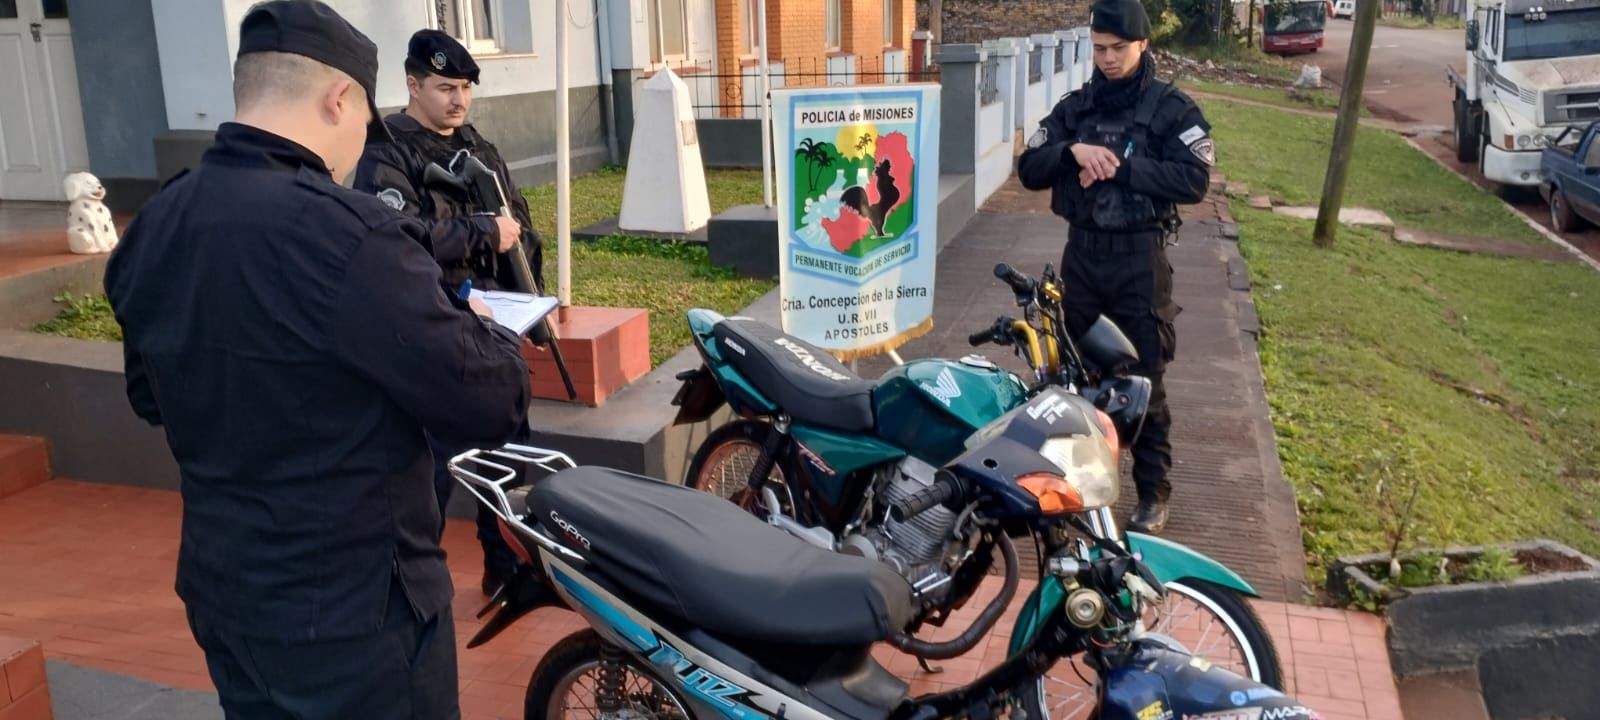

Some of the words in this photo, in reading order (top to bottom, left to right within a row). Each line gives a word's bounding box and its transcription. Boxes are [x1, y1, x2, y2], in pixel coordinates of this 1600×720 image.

[801, 110, 846, 124] POLICIA
[849, 109, 861, 121] de
[863, 107, 914, 120] MISIONES
[795, 254, 842, 273] PERMANENTE
[844, 260, 874, 277] VOCACION
[874, 256, 884, 268] DE
[883, 243, 911, 264] SERVICIO
[872, 291, 882, 302] de
[885, 288, 894, 300] la
[896, 286, 927, 298] Sierra
[838, 312, 862, 324] U.R.
[864, 310, 877, 321] VII
[824, 322, 889, 340] APOSTOLES
[920, 382, 951, 408] HONDA
